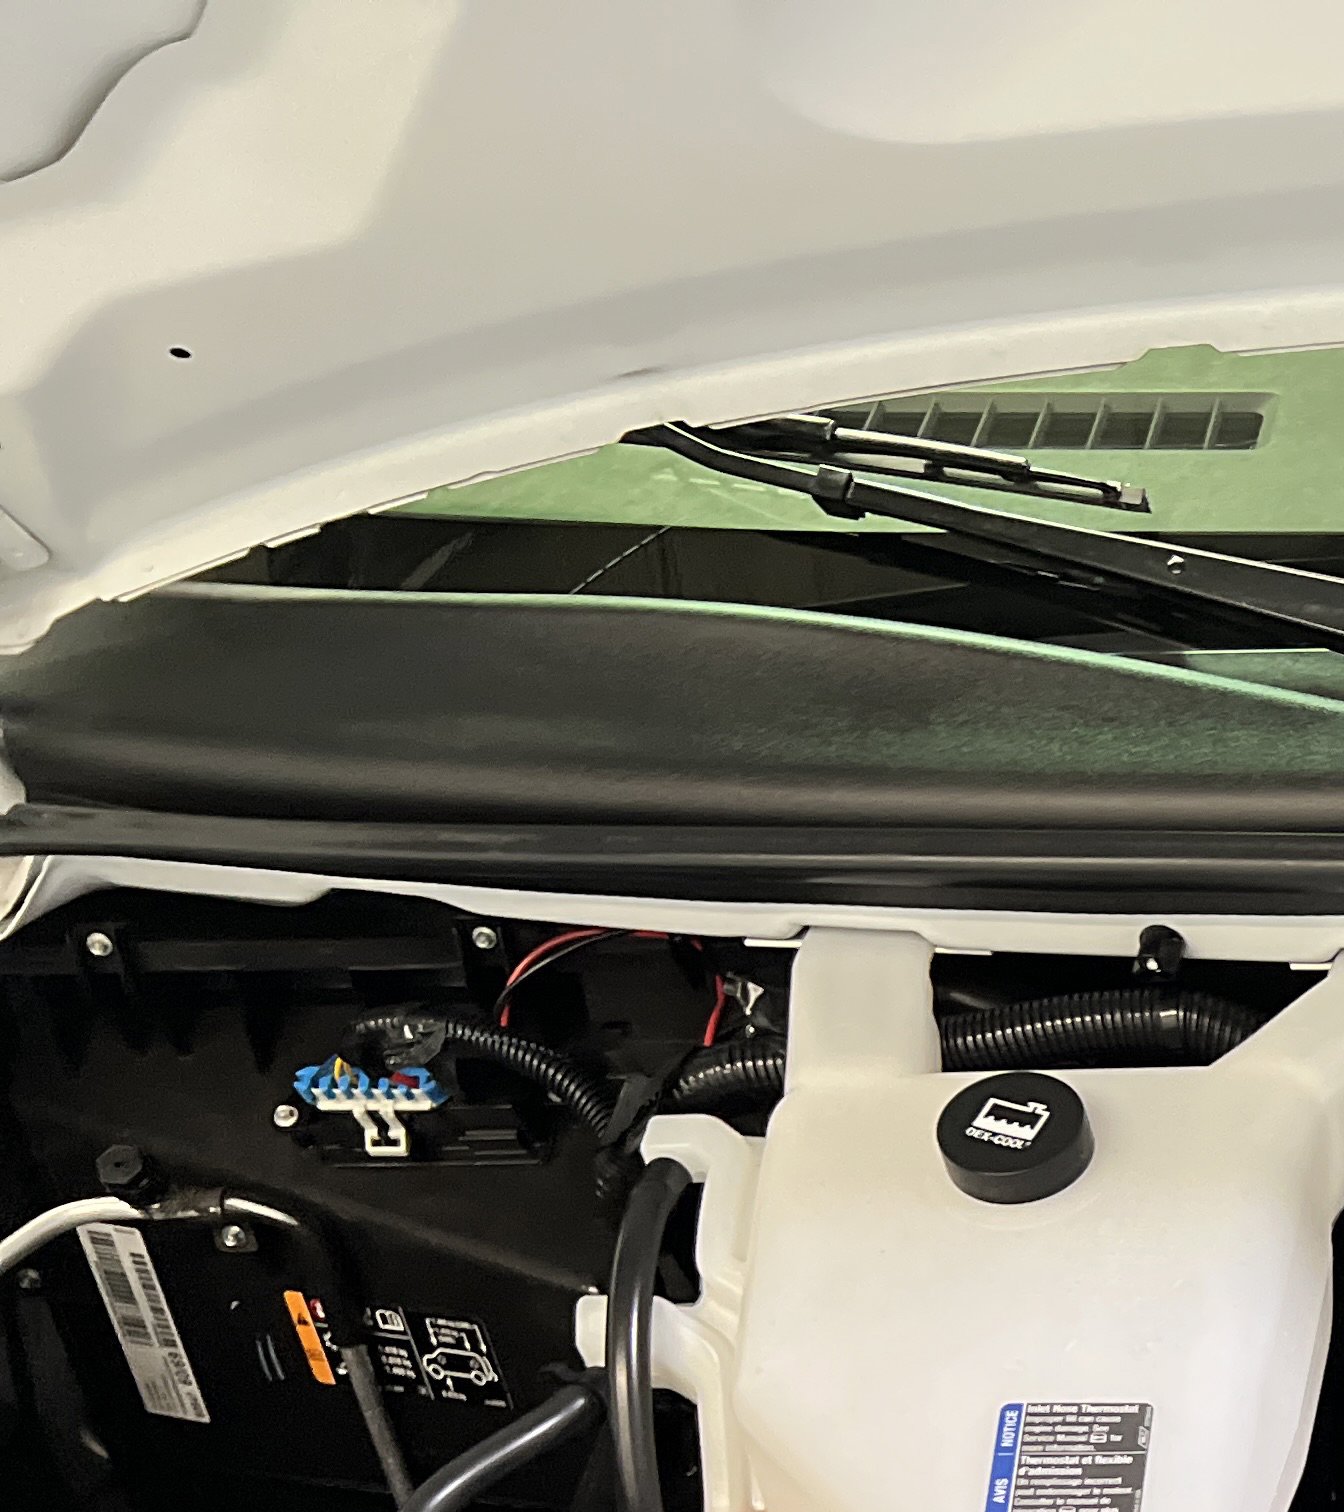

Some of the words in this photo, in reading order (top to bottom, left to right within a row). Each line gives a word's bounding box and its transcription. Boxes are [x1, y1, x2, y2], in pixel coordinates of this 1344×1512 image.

[1081, 1404, 1139, 1414] Thermostat
[1001, 1410, 1019, 1447] NOTICE
[1021, 1455, 1080, 1465] Thermostat
[992, 1477, 1009, 1504] AVIS
